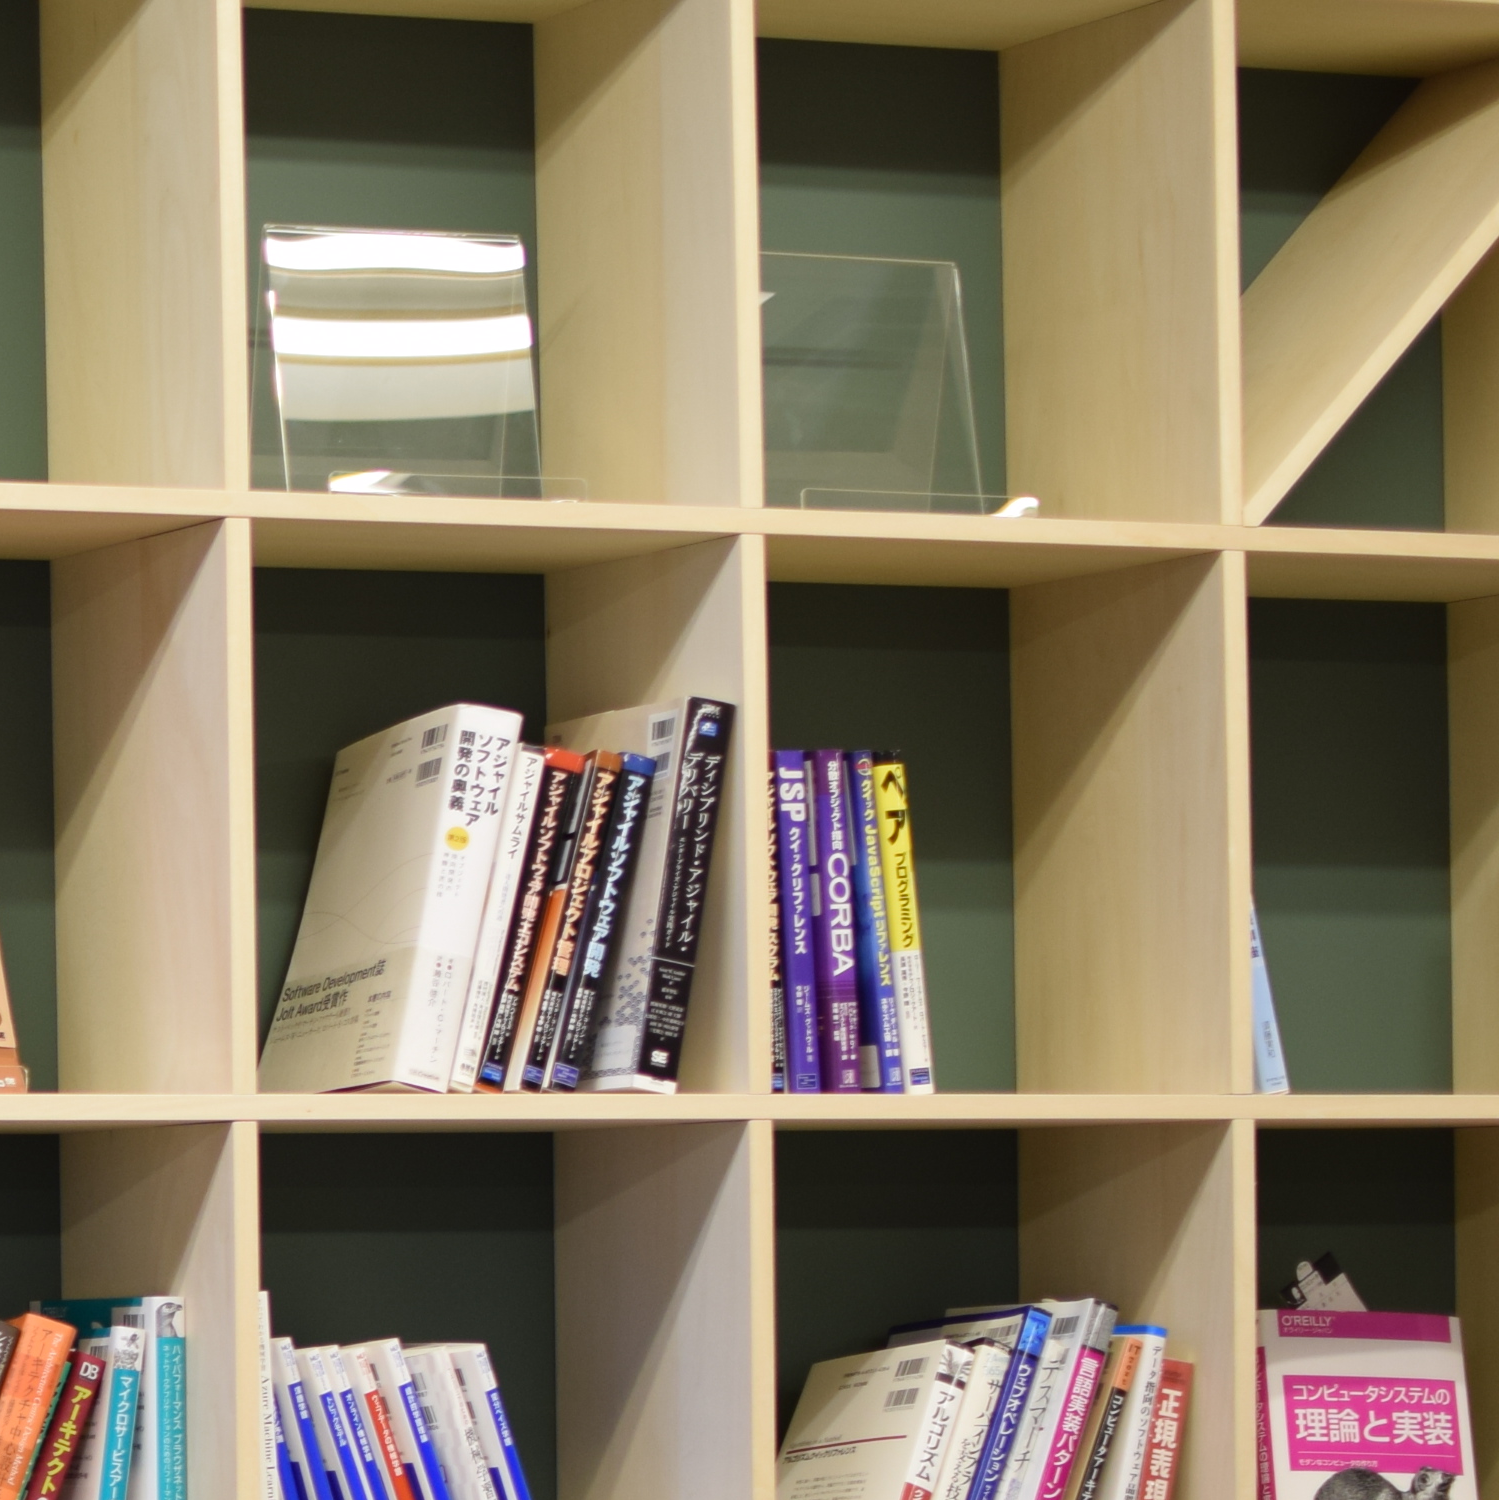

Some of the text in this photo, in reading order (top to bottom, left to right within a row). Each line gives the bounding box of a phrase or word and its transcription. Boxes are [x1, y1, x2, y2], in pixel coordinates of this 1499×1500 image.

[449, 729, 476, 812] 開発の奥義
[465, 734, 494, 827] ソフトウェア
[484, 737, 511, 816] アジャイル
[507, 756, 538, 860] アジャイルサムライ
[681, 752, 704, 830] デリバリー
[779, 767, 806, 822] JSP
[827, 761, 844, 850] 分散オブジェクト指向
[861, 779, 874, 820] クイック
[881, 767, 908, 844] ペア
[504, 771, 569, 994] アジャイルソフトウェア開発エコシステム
[553, 772, 615, 976] アジャイルプロジェクト管理
[581, 774, 645, 979] アジャイルソフトウェア開発
[789, 827, 807, 955] クイックリファレンス
[828, 853, 854, 976] CORBA
[894, 852, 912, 948] プログラミング
[282, 982, 320, 1003] Software
[1281, 1314, 1336, 1327] O'REILLY
[172, 1345, 184, 1430] ハイパフォーマンス
[261, 1376, 271, 1411] Azure
[985, 1363, 1032, 1482] ウェブオペレーション
[1013, 1360, 1059, 1473] デスマーチ
[1042, 1356, 1099, 1500] 言語実装パターン
[1292, 1384, 1451, 1406] コンピュータシステムの
[1294, 1407, 1455, 1446] 理論と実装
[263, 1413, 275, 1463] Machine
[916, 1390, 955, 1483] アルゴリズム
